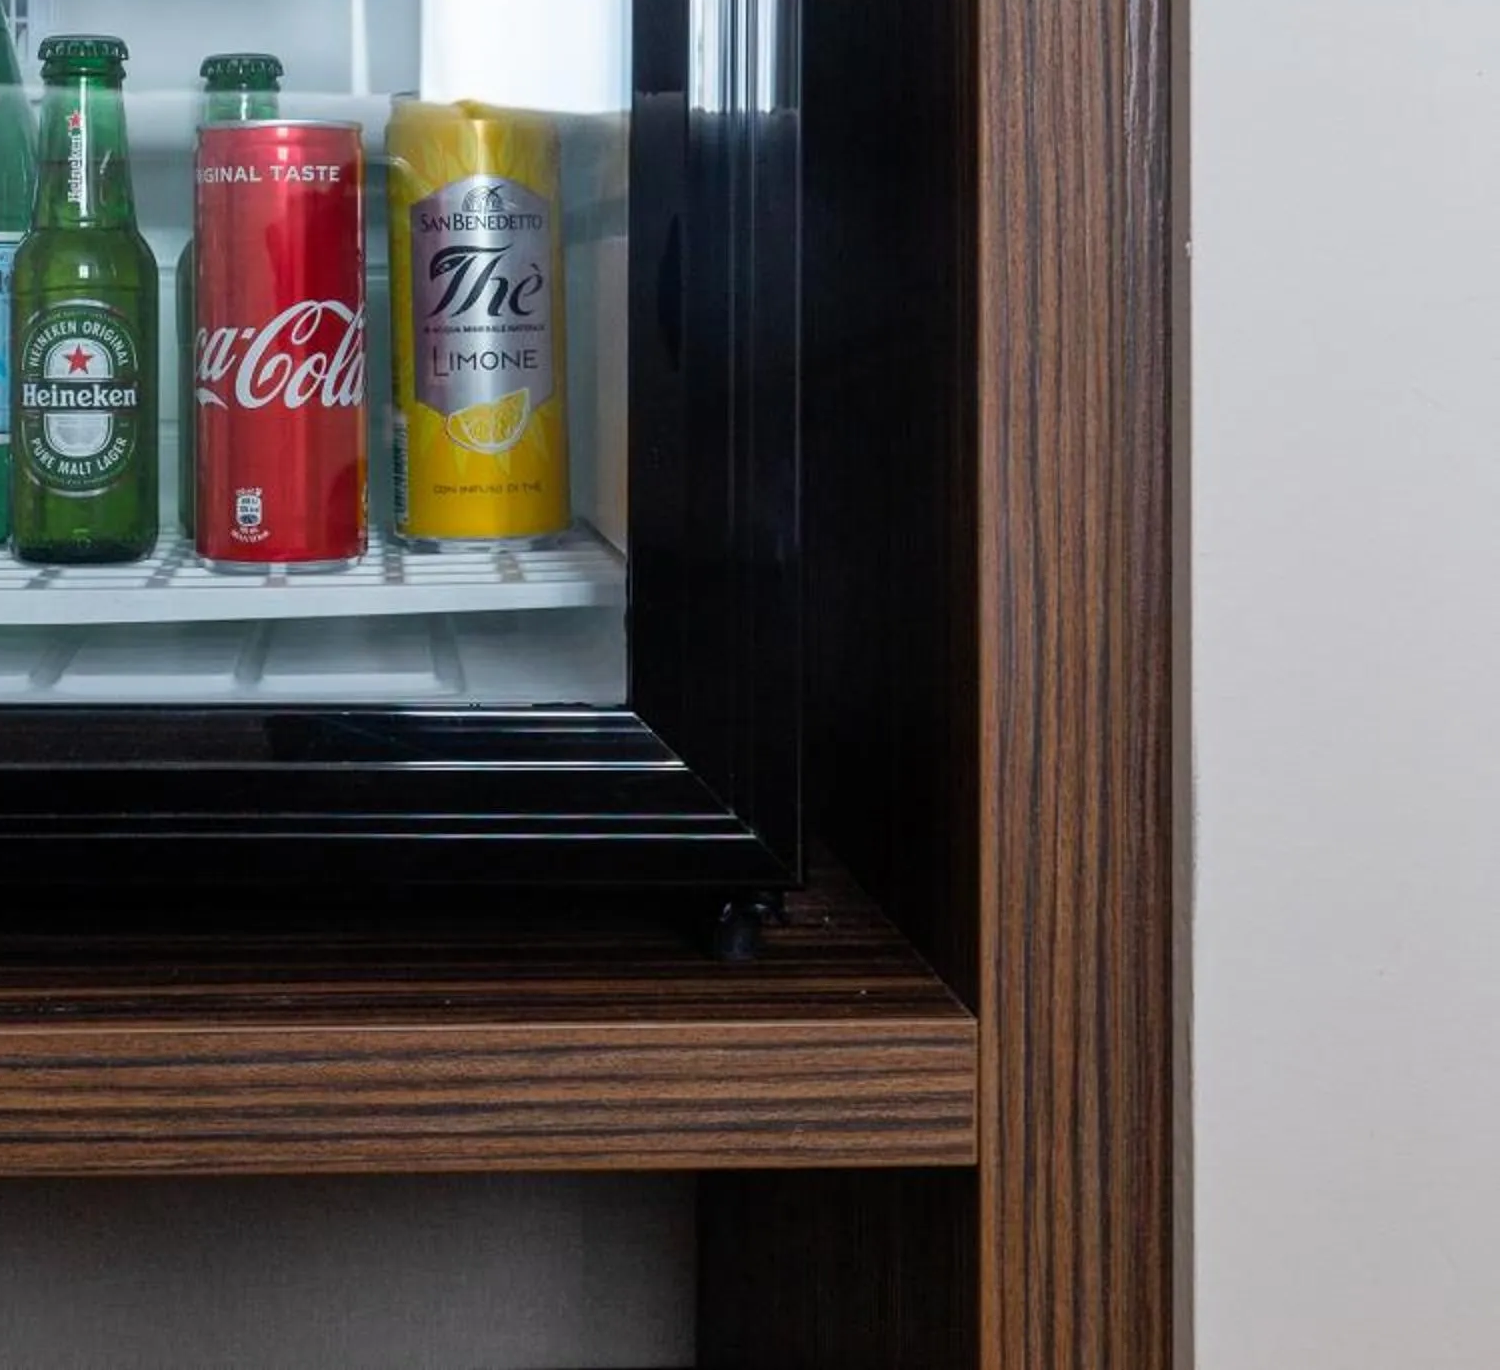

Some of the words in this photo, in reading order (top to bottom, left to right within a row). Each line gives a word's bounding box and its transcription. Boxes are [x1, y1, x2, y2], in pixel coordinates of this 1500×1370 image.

[270, 165, 341, 182] TASTE
[425, 244, 544, 318] Thè
[29, 320, 77, 367] HEINEKEN
[82, 320, 129, 367] ORIGINAL
[433, 345, 538, 377] LIMONE
[21, 382, 138, 408] Heineken
[30, 436, 55, 470] PURE
[56, 460, 92, 476] MALT
[97, 436, 128, 471] LAGER
